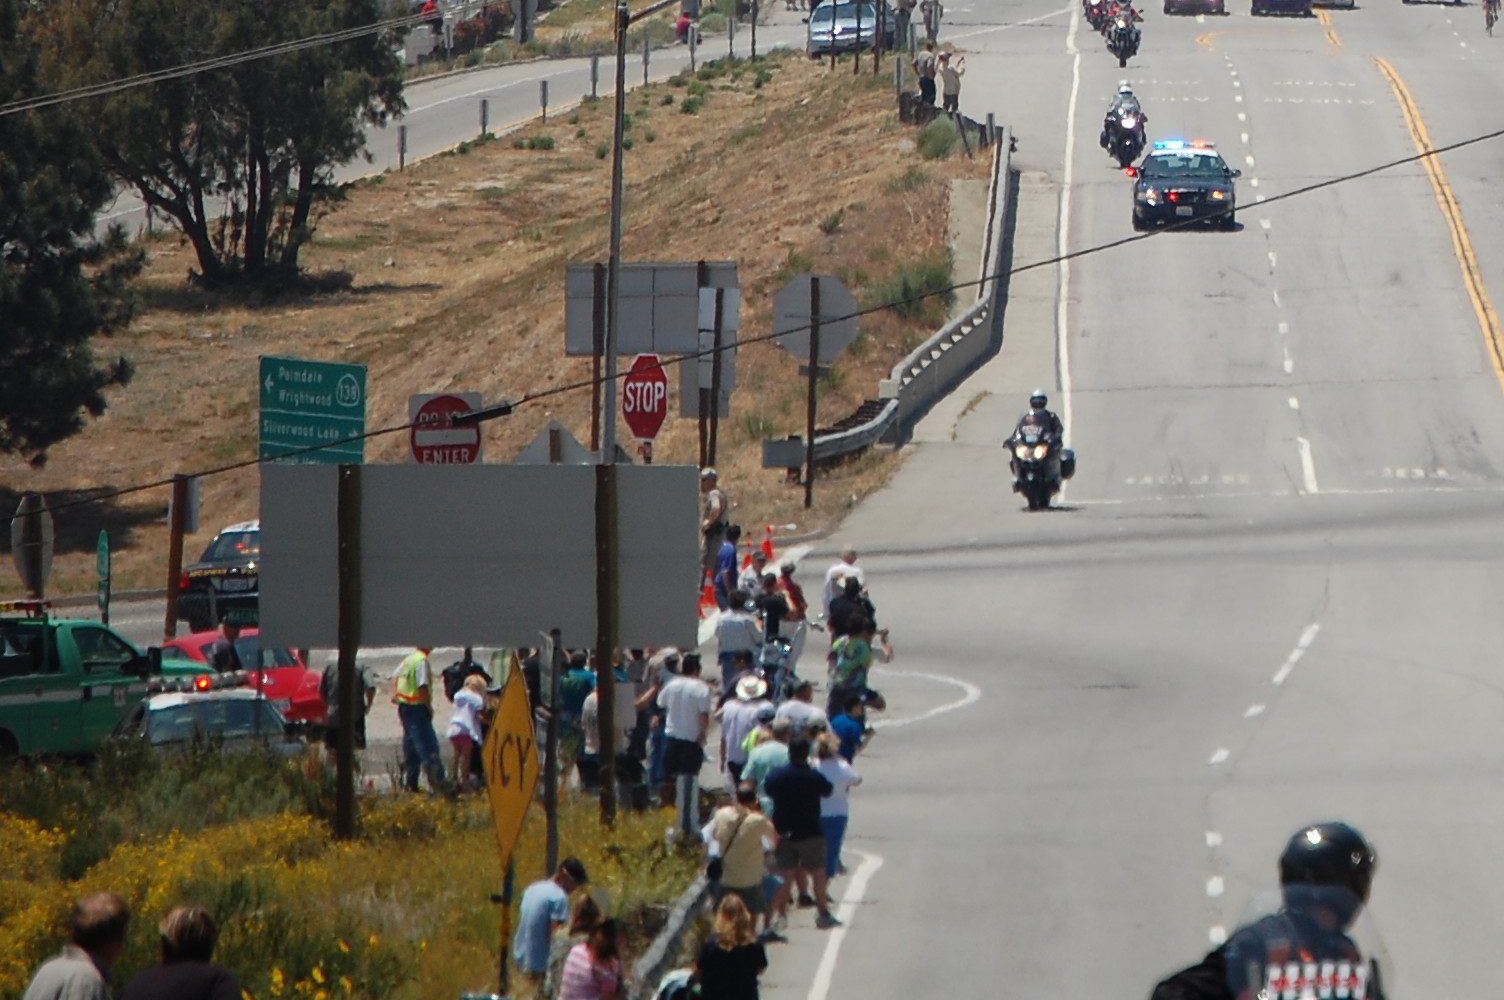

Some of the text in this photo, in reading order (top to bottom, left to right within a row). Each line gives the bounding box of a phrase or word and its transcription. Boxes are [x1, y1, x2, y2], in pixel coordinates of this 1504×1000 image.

[279, 366, 323, 383] Palmdale
[280, 385, 357, 407] Wrightwood 138
[624, 381, 665, 413] STOP
[420, 412, 439, 426] DO
[317, 427, 340, 439] Lake
[423, 447, 470, 464] ENTER
[491, 728, 532, 792] ICY
